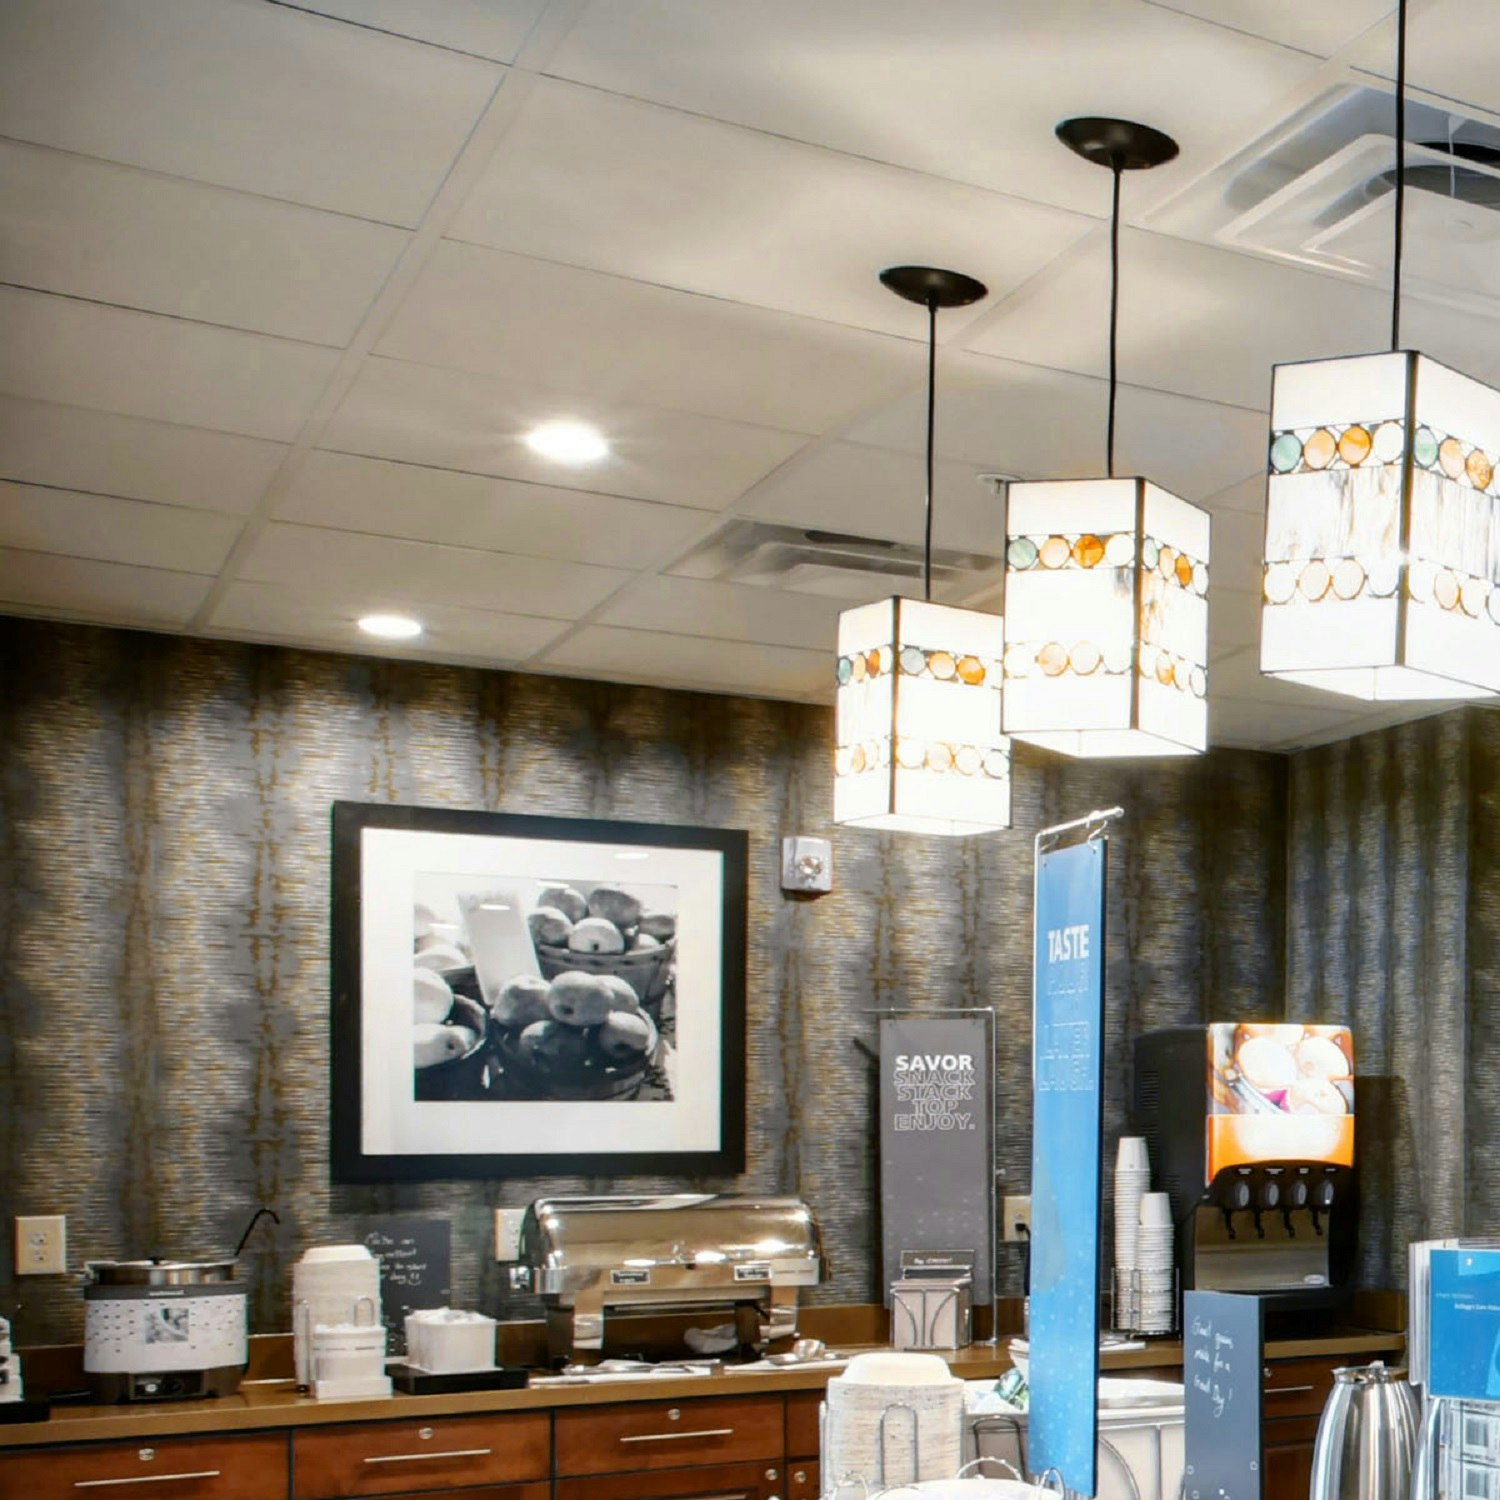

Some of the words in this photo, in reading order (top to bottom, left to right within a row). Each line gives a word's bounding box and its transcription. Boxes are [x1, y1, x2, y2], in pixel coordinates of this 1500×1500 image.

[1048, 924, 1090, 964] TASTE
[895, 1055, 973, 1071] SAVOR
[893, 1069, 976, 1086] SNACK
[896, 1084, 973, 1101] STACK
[911, 1098, 959, 1115] TOP
[894, 1113, 976, 1131] ENJOY.
